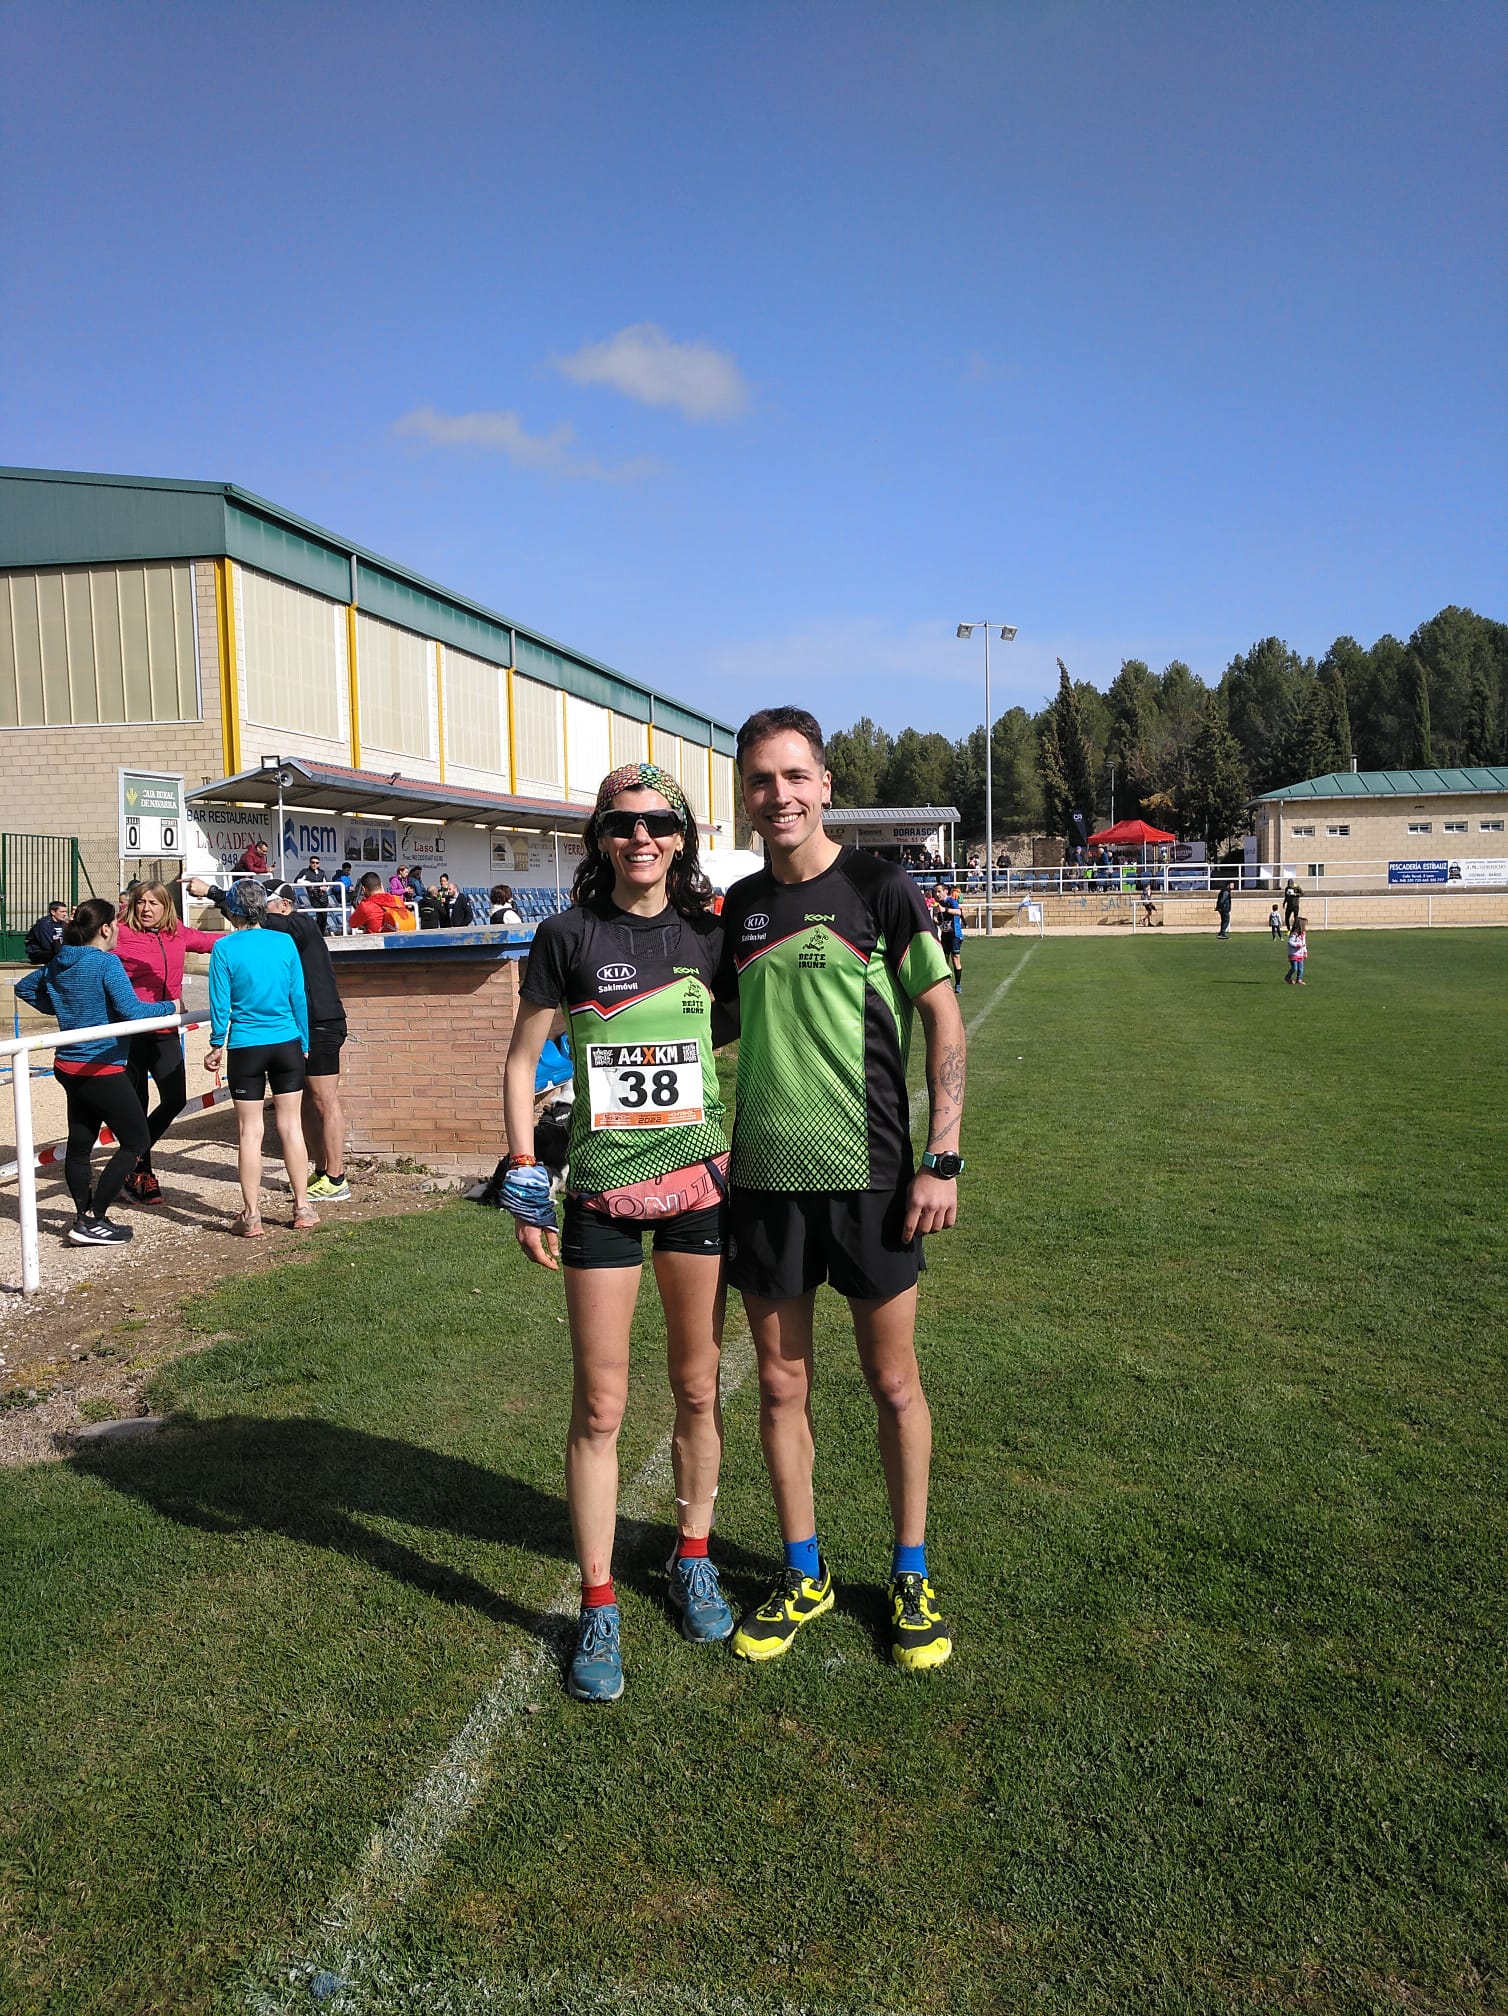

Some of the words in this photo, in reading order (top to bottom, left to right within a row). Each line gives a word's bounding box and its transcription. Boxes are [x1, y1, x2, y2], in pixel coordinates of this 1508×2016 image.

[187, 809, 206, 823] BAR
[208, 810, 269, 826] RESTAURANTE
[128, 825, 138, 847] 0
[163, 827, 174, 847] 0
[196, 830, 214, 849] LA
[299, 824, 337, 853] nsm
[893, 827, 938, 838] BORRASCO
[414, 841, 434, 853] Laso
[221, 853, 238, 866] 948
[603, 966, 631, 979] KIA
[618, 1045, 678, 1065] A4XKM
[618, 1069, 679, 1109] 38
